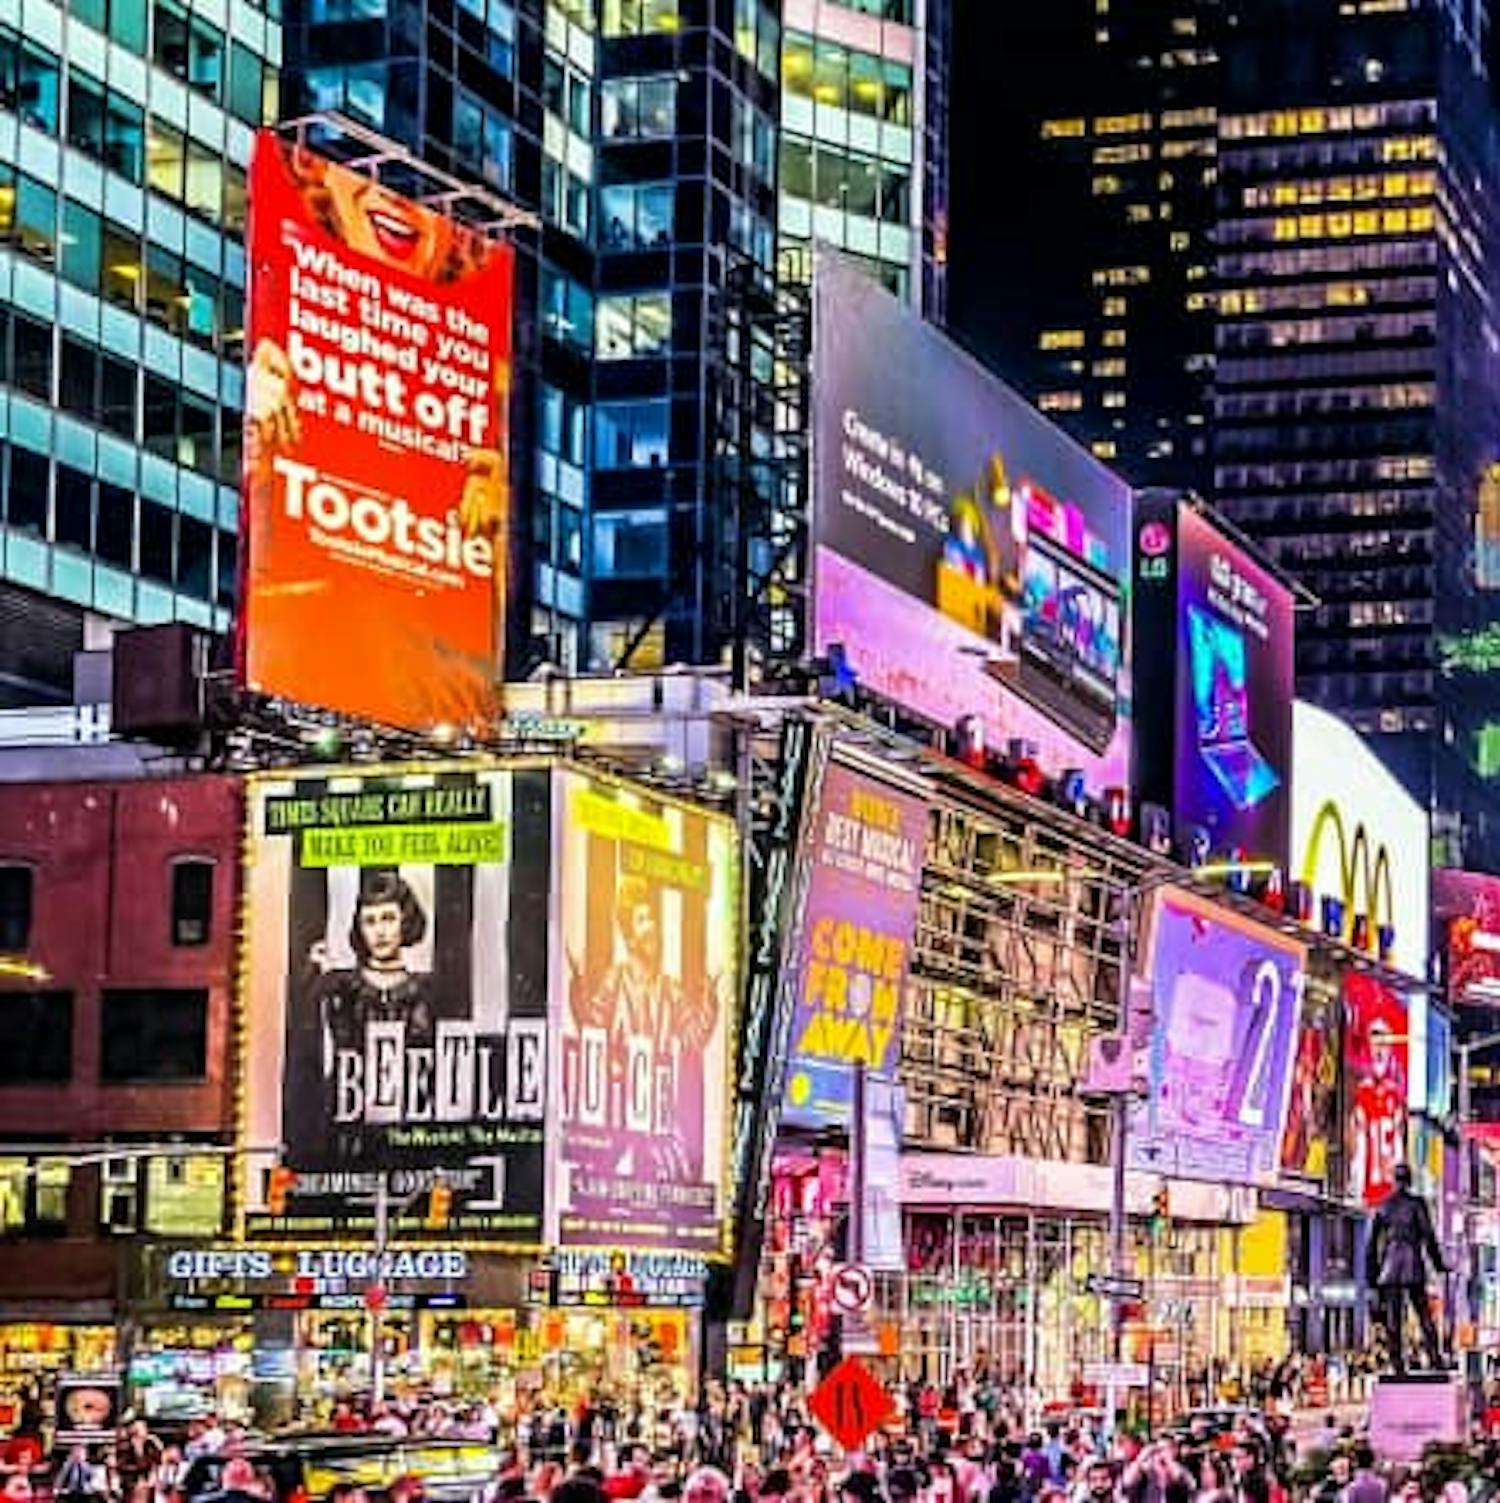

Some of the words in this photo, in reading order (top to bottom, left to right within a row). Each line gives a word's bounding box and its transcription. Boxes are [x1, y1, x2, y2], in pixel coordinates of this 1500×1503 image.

[290, 266, 351, 315] last
[359, 296, 429, 345] time
[436, 332, 489, 370] you
[386, 284, 441, 322] was
[445, 307, 489, 344] the
[290, 298, 418, 373] laughed
[423, 358, 489, 399] your
[288, 330, 407, 416] butt
[415, 393, 489, 444] off
[298, 387, 328, 416] at
[334, 402, 351, 424] a
[273, 455, 493, 578] Tootsie
[387, 792, 422, 817] CAN
[424, 785, 487, 815] REALLY
[309, 831, 357, 860] MAKE
[364, 831, 396, 857] YOU
[400, 830, 440, 856] FEEL
[812, 918, 905, 978] COME
[805, 961, 899, 1018] FROM
[797, 1010, 896, 1070] AWAY
[335, 1018, 547, 1123] BEETLE
[169, 1251, 271, 1278] GIFTS
[297, 1251, 466, 1278] LUGGAGE
